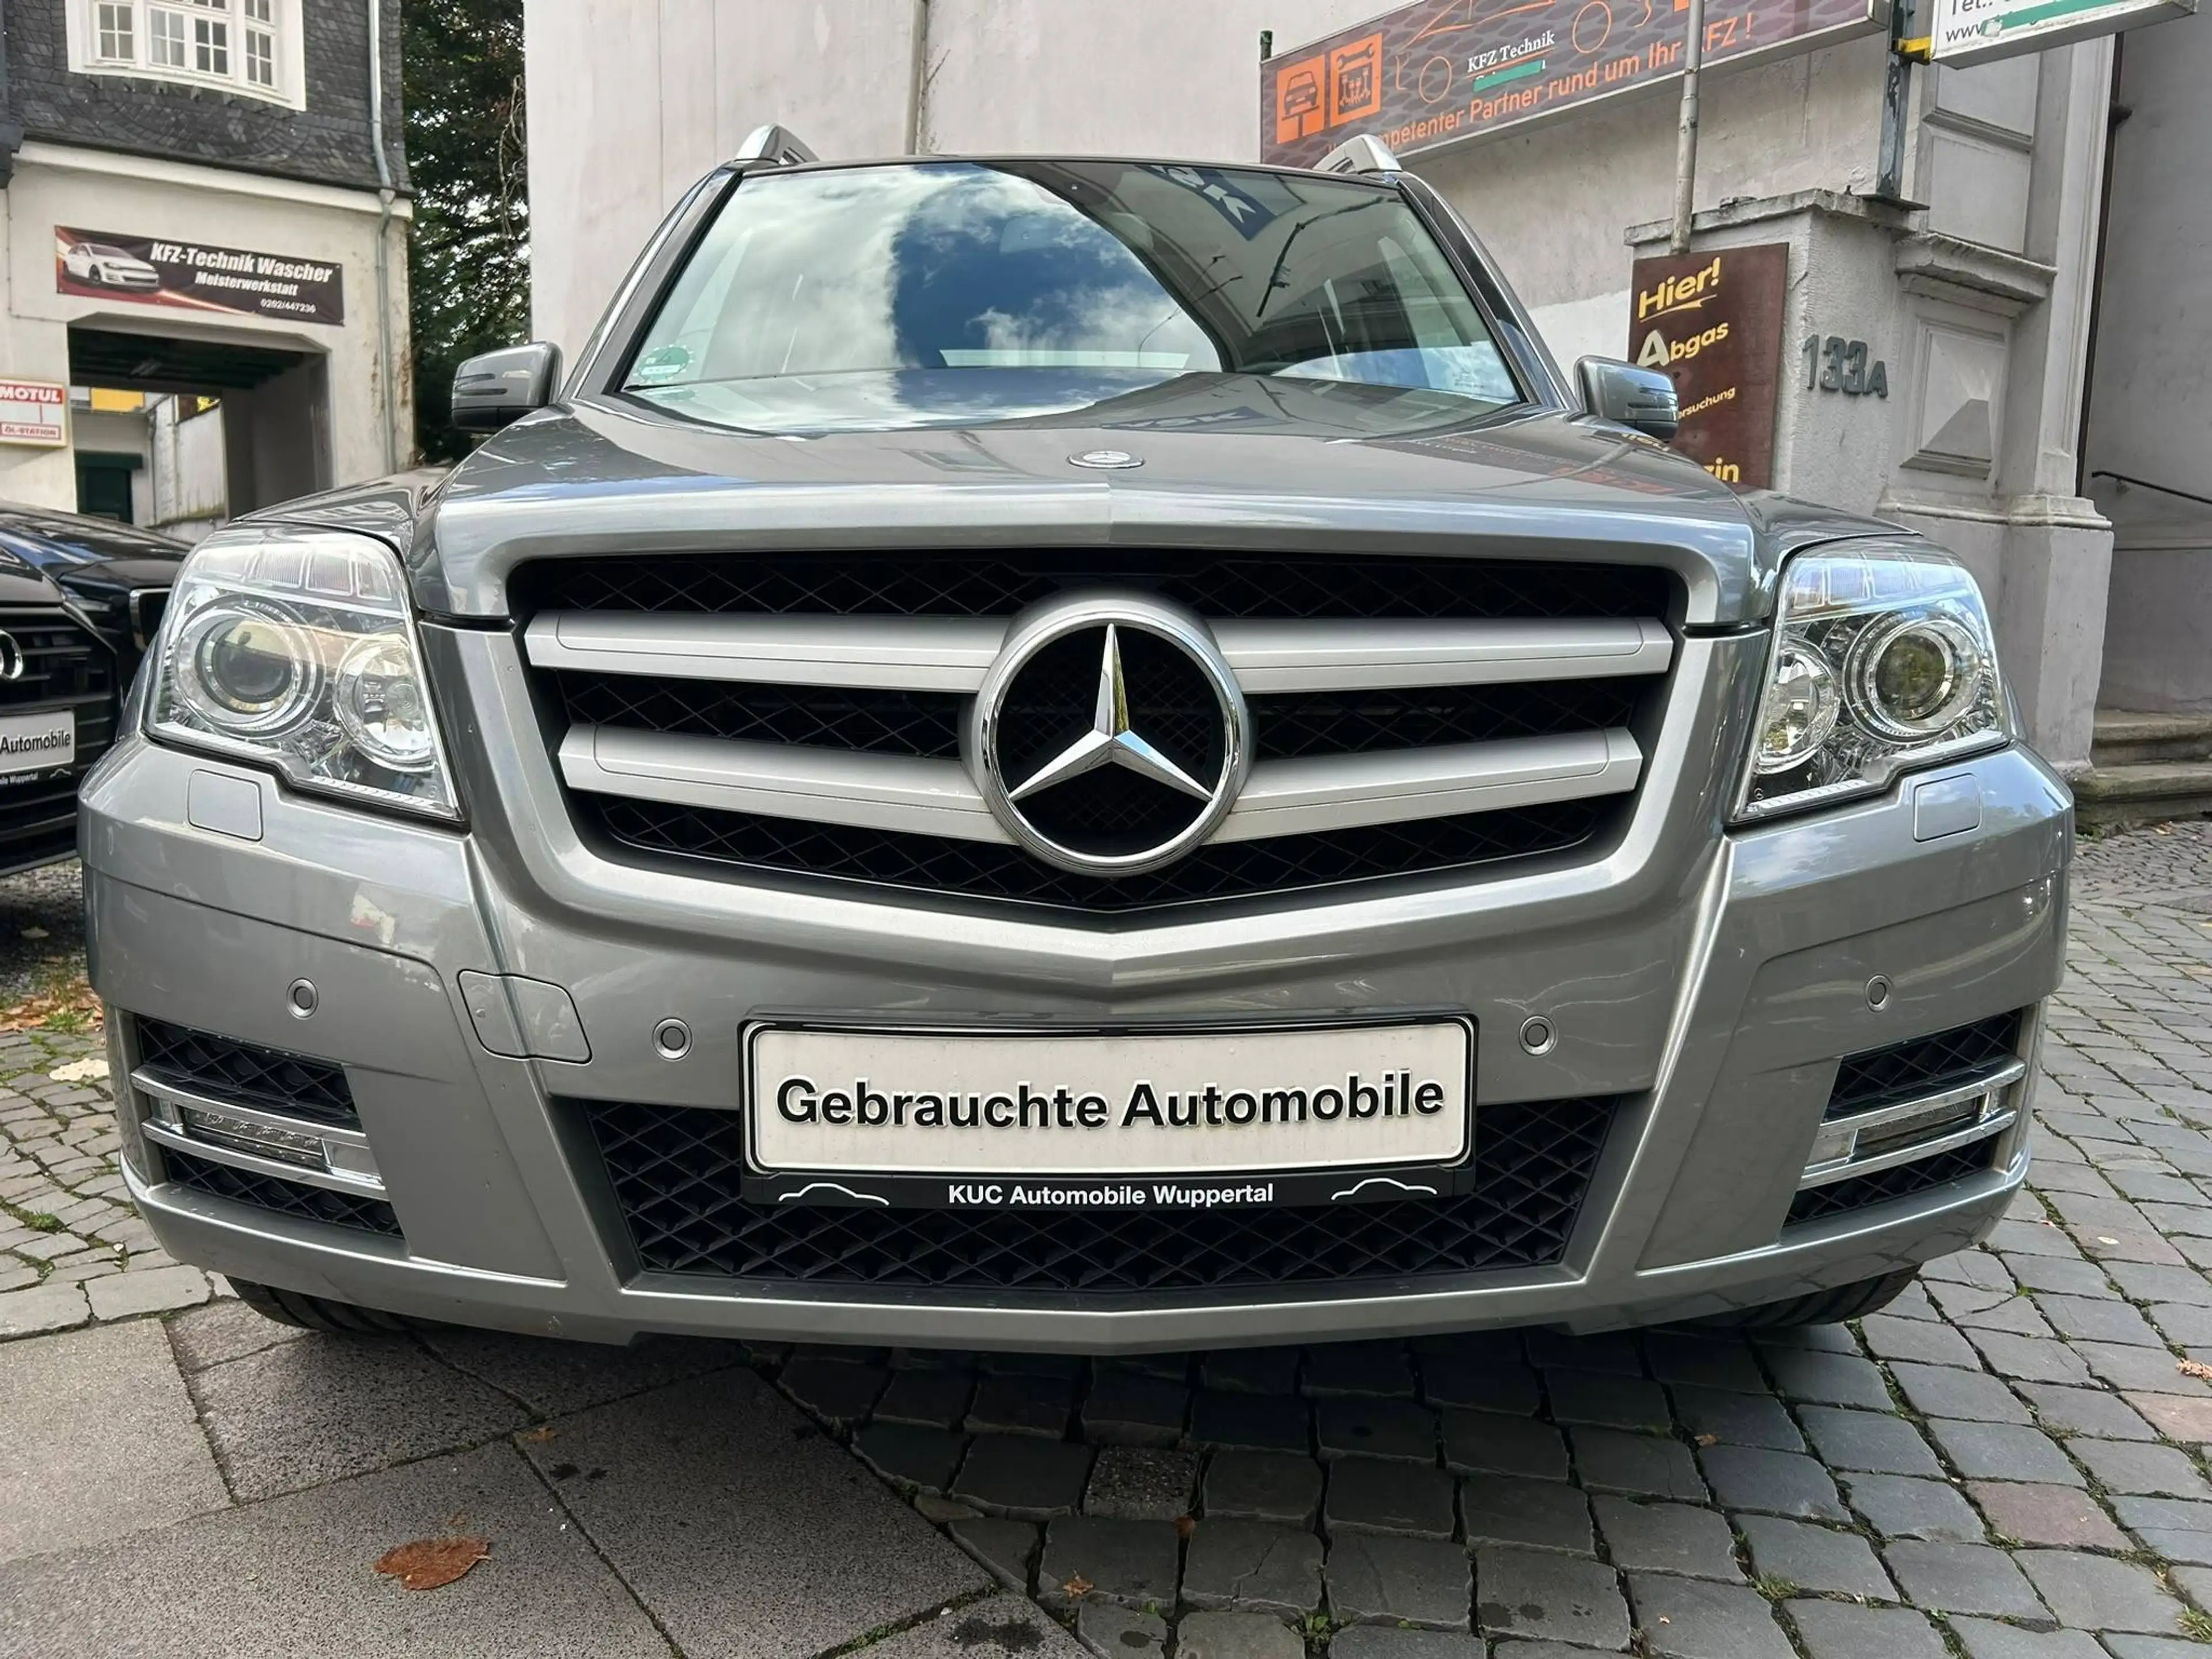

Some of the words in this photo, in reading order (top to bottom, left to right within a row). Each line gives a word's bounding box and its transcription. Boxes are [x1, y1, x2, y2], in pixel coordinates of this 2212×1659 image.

[1467, 50, 1498, 74] KFZ
[1500, 30, 1555, 63] Technik
[1469, 84, 1543, 123] Partner
[1547, 61, 1597, 100] rund
[1604, 55, 1641, 82] um
[1647, 40, 1683, 70] Ihr
[1701, 16, 1738, 53] FZ
[150, 241, 255, 273] KFZ-Technik
[257, 257, 333, 283] Wascher
[194, 271, 298, 297] Meisterwerkstatt
[1638, 256, 1721, 318] Hier!
[1637, 322, 1729, 366] Abgas
[1802, 334, 1888, 397] 133A
[0, 387, 60, 402] MOTUL
[0, 729, 71, 753] Automobile
[776, 1077, 1108, 1128] Gebrauchte
[1120, 1069, 1444, 1127] Automobile
[948, 1184, 1003, 1205] KUC
[1010, 1185, 1146, 1205] Automobile
[1153, 1183, 1274, 1207] Wuppertal
